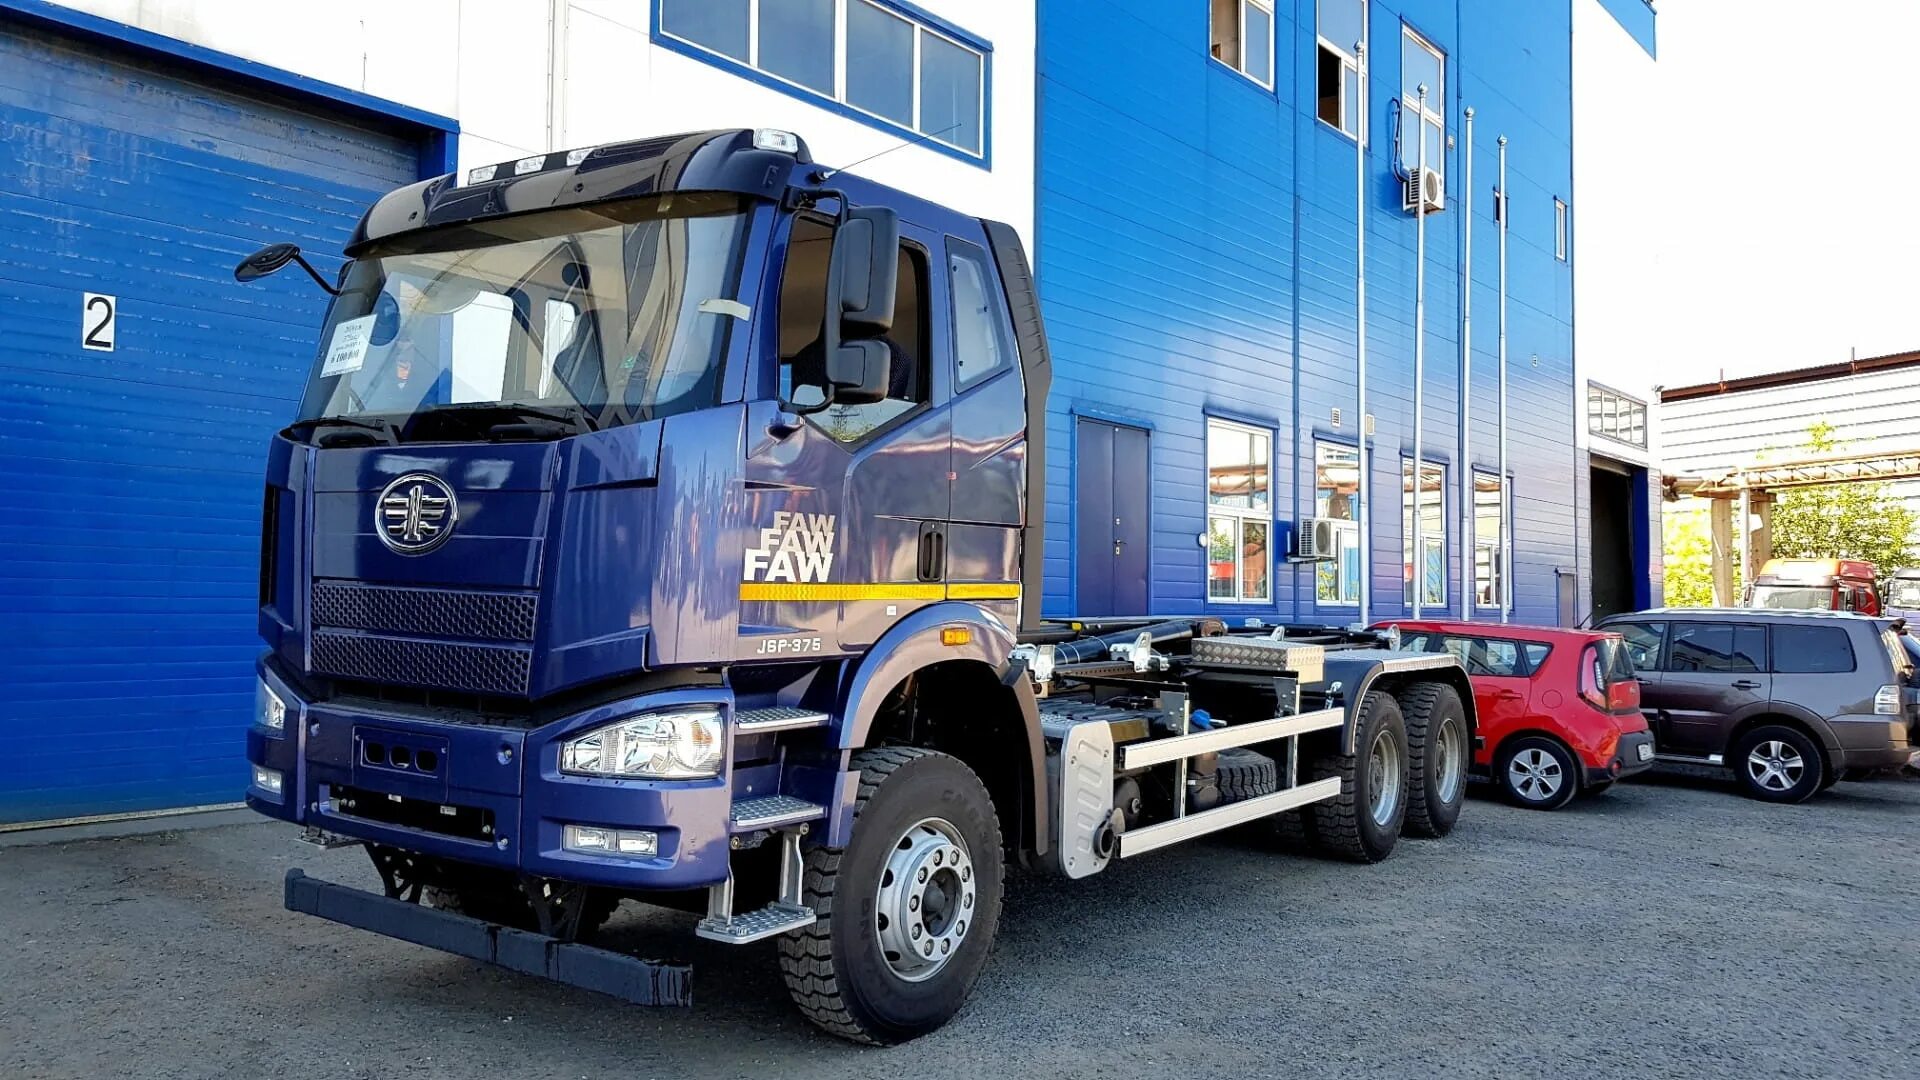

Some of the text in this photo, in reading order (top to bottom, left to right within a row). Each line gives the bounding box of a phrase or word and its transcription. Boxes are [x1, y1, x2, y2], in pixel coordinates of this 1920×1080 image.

[85, 296, 113, 348] 2
[773, 511, 836, 537] FAW
[760, 528, 835, 558] FAW
[743, 548, 834, 582] FAW
[756, 637, 821, 654] J6P-375
